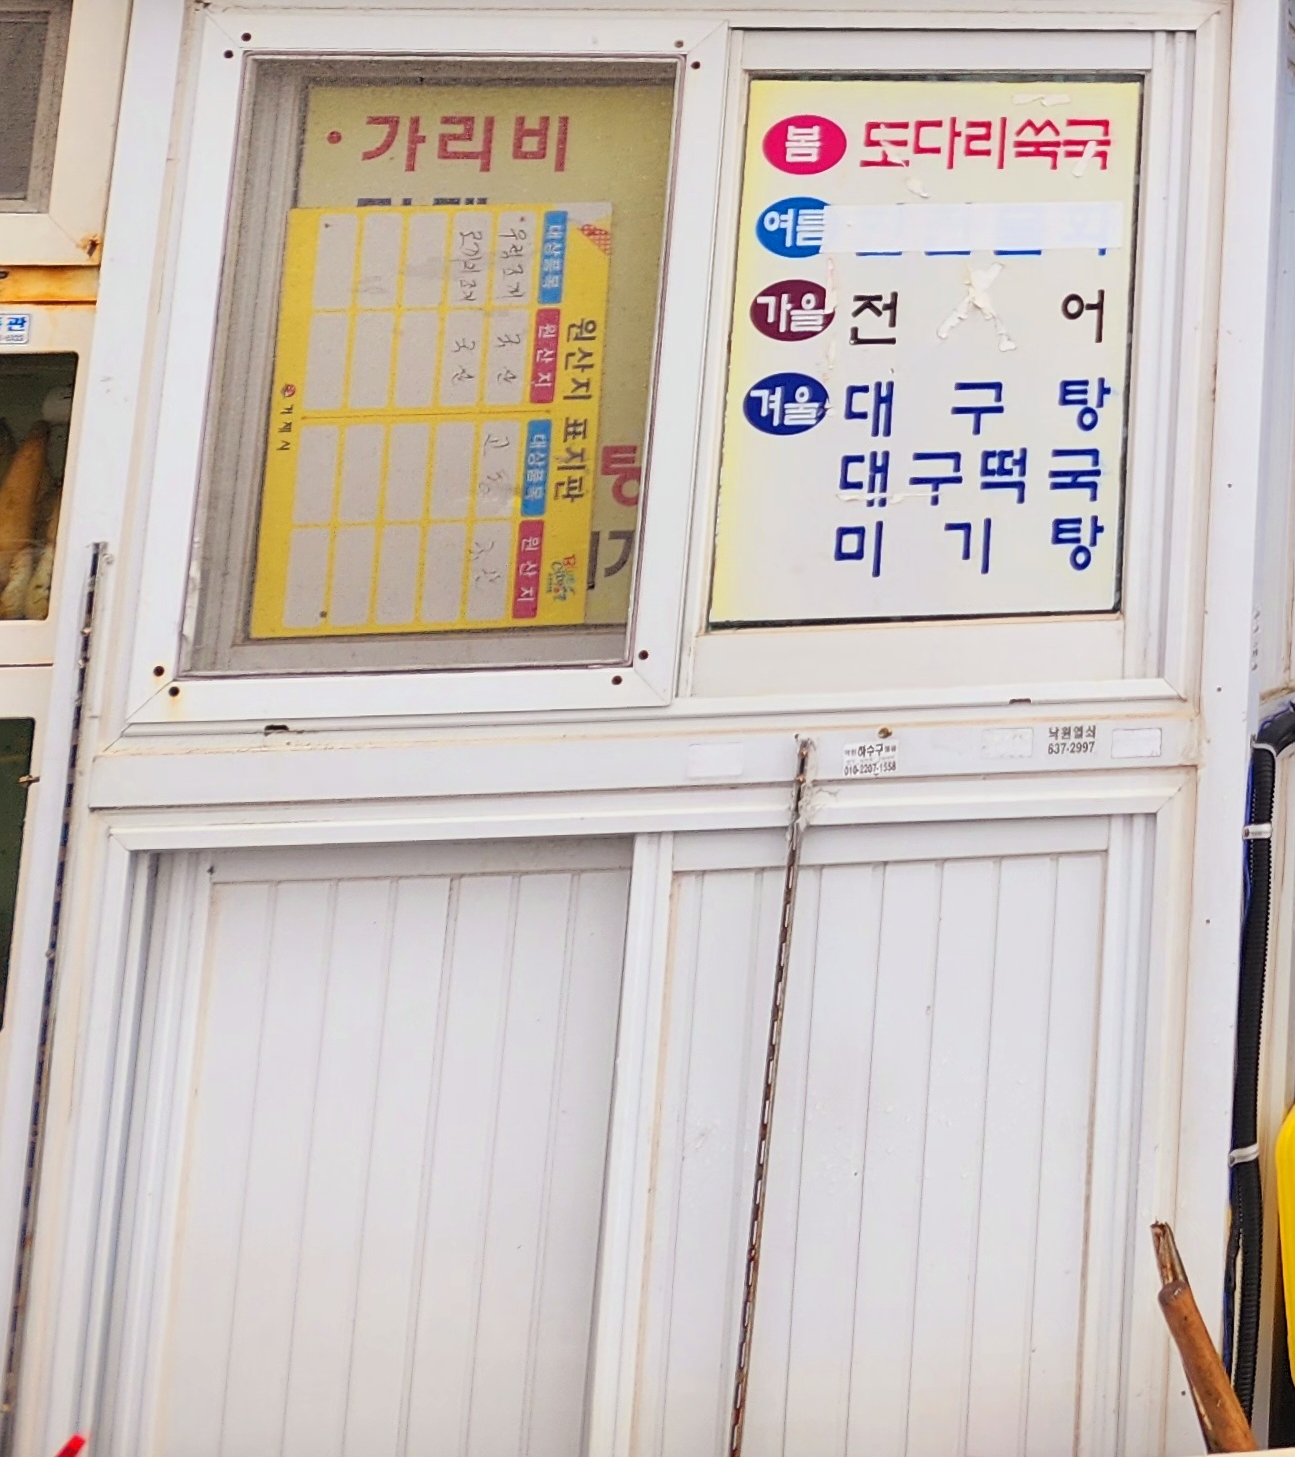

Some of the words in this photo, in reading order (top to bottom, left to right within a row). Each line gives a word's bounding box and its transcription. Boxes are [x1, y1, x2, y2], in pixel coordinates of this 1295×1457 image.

[361, 115, 570, 173] 가리비
[784, 124, 821, 163] 봄
[756, 293, 826, 332] 가을
[534, 323, 557, 388] 원산지
[563, 319, 597, 401] 원산지
[750, 386, 826, 427] 겨울
[839, 447, 1102, 507] 대구떡국
[517, 536, 541, 603] 원산지
